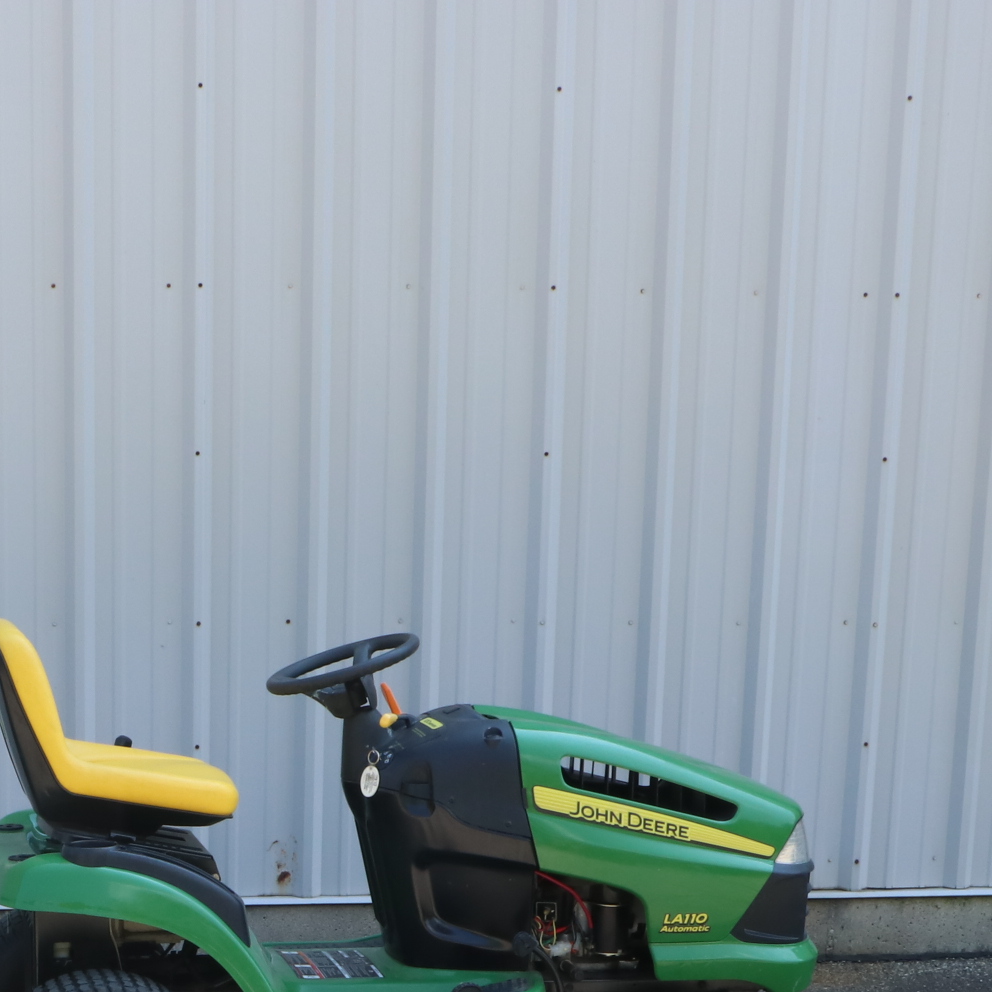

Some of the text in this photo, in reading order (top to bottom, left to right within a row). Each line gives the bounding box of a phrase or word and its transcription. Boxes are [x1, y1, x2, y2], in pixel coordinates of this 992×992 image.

[569, 801, 690, 838] JOHN DEERE
[663, 913, 708, 924] LA110
[659, 925, 710, 933] Automatic
